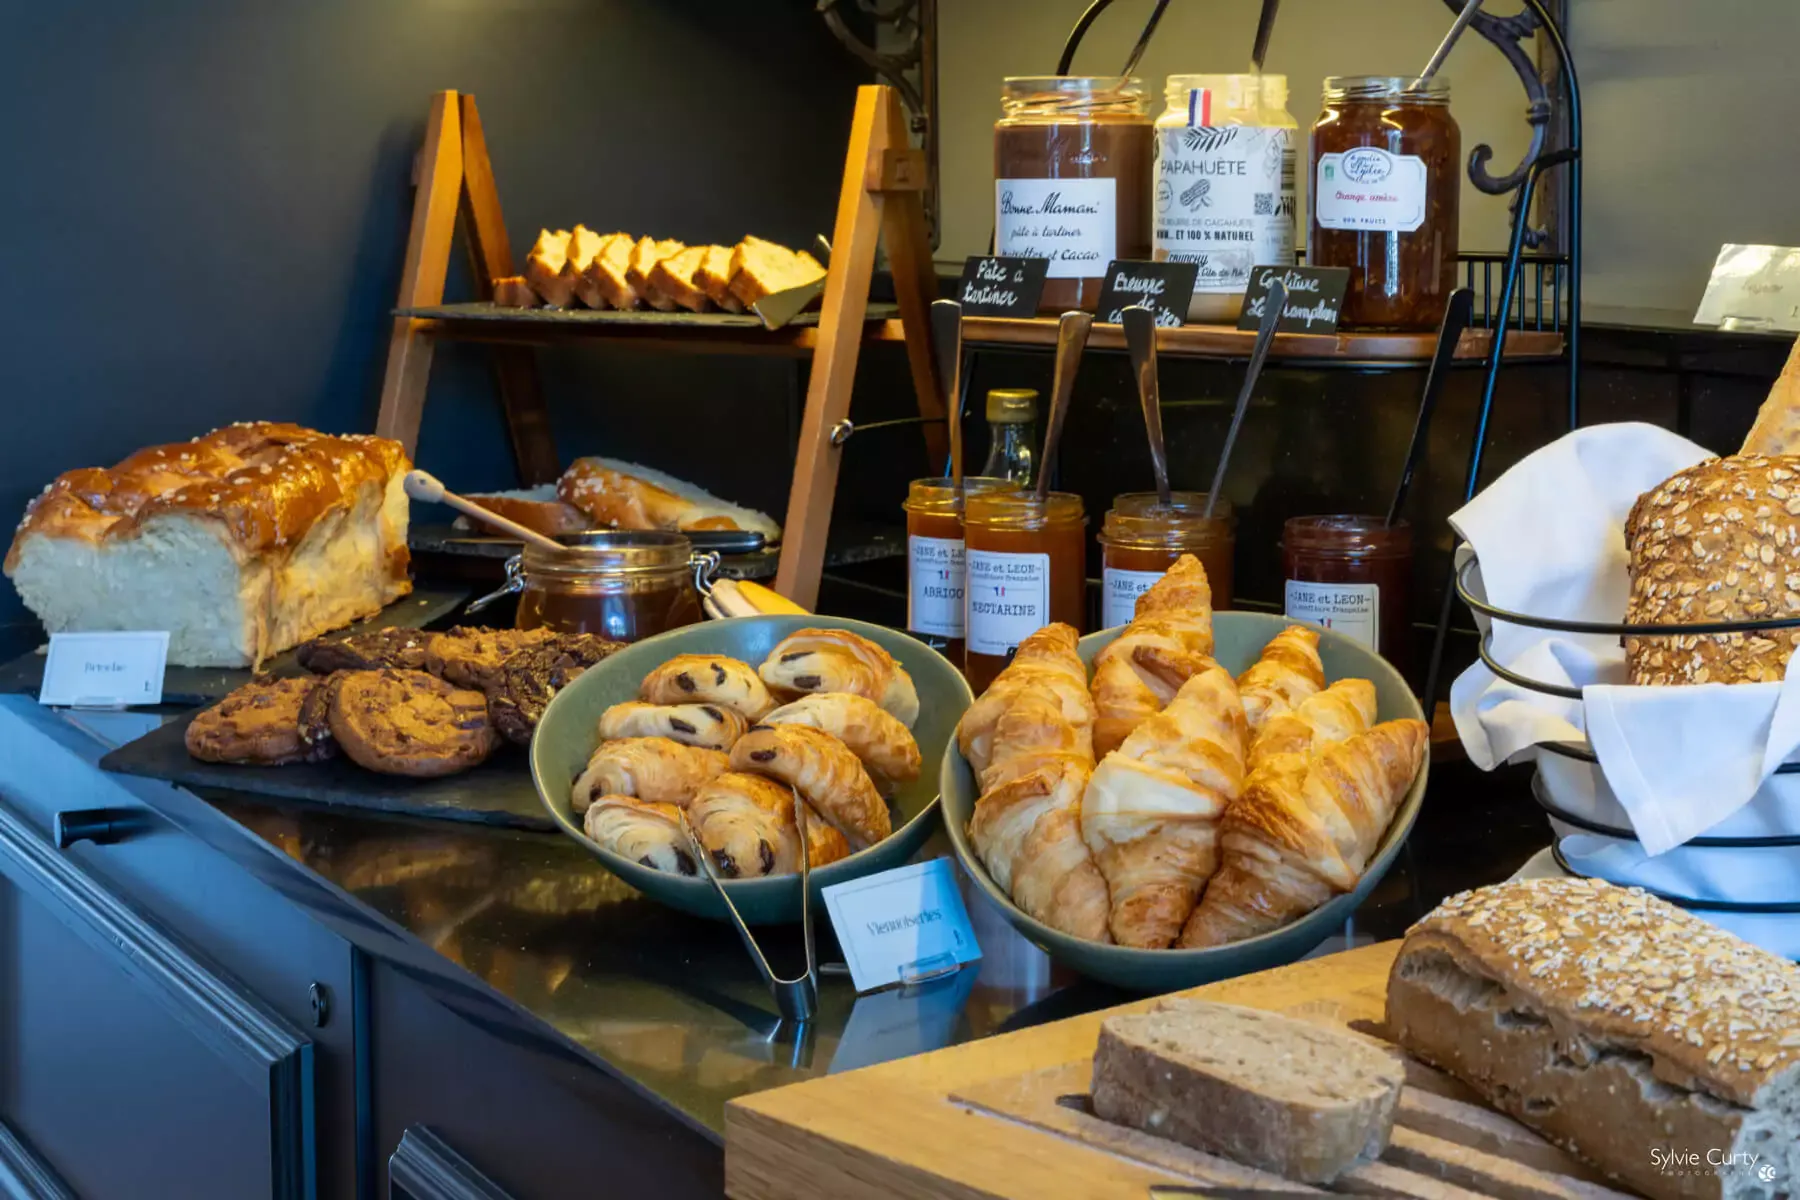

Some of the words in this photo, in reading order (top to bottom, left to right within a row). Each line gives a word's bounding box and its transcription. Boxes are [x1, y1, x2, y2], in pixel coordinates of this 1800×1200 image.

[1001, 190, 1034, 215] Bonne
[1176, 229, 1185, 241] ET
[1187, 229, 1201, 241] 100
[1204, 230, 1211, 241] %
[1214, 230, 1255, 241] NATUREL
[1060, 249, 1100, 261] Cacao
[976, 257, 1007, 282] Pâte
[1013, 260, 1026, 283] à
[1112, 271, 1165, 294] Beurre
[962, 280, 1018, 307] tartiner
[1136, 294, 1155, 312] de
[993, 564, 1004, 572] et
[923, 585, 965, 599] ABRICO
[1319, 595, 1331, 604] et
[972, 601, 1036, 616] NECTARINE
